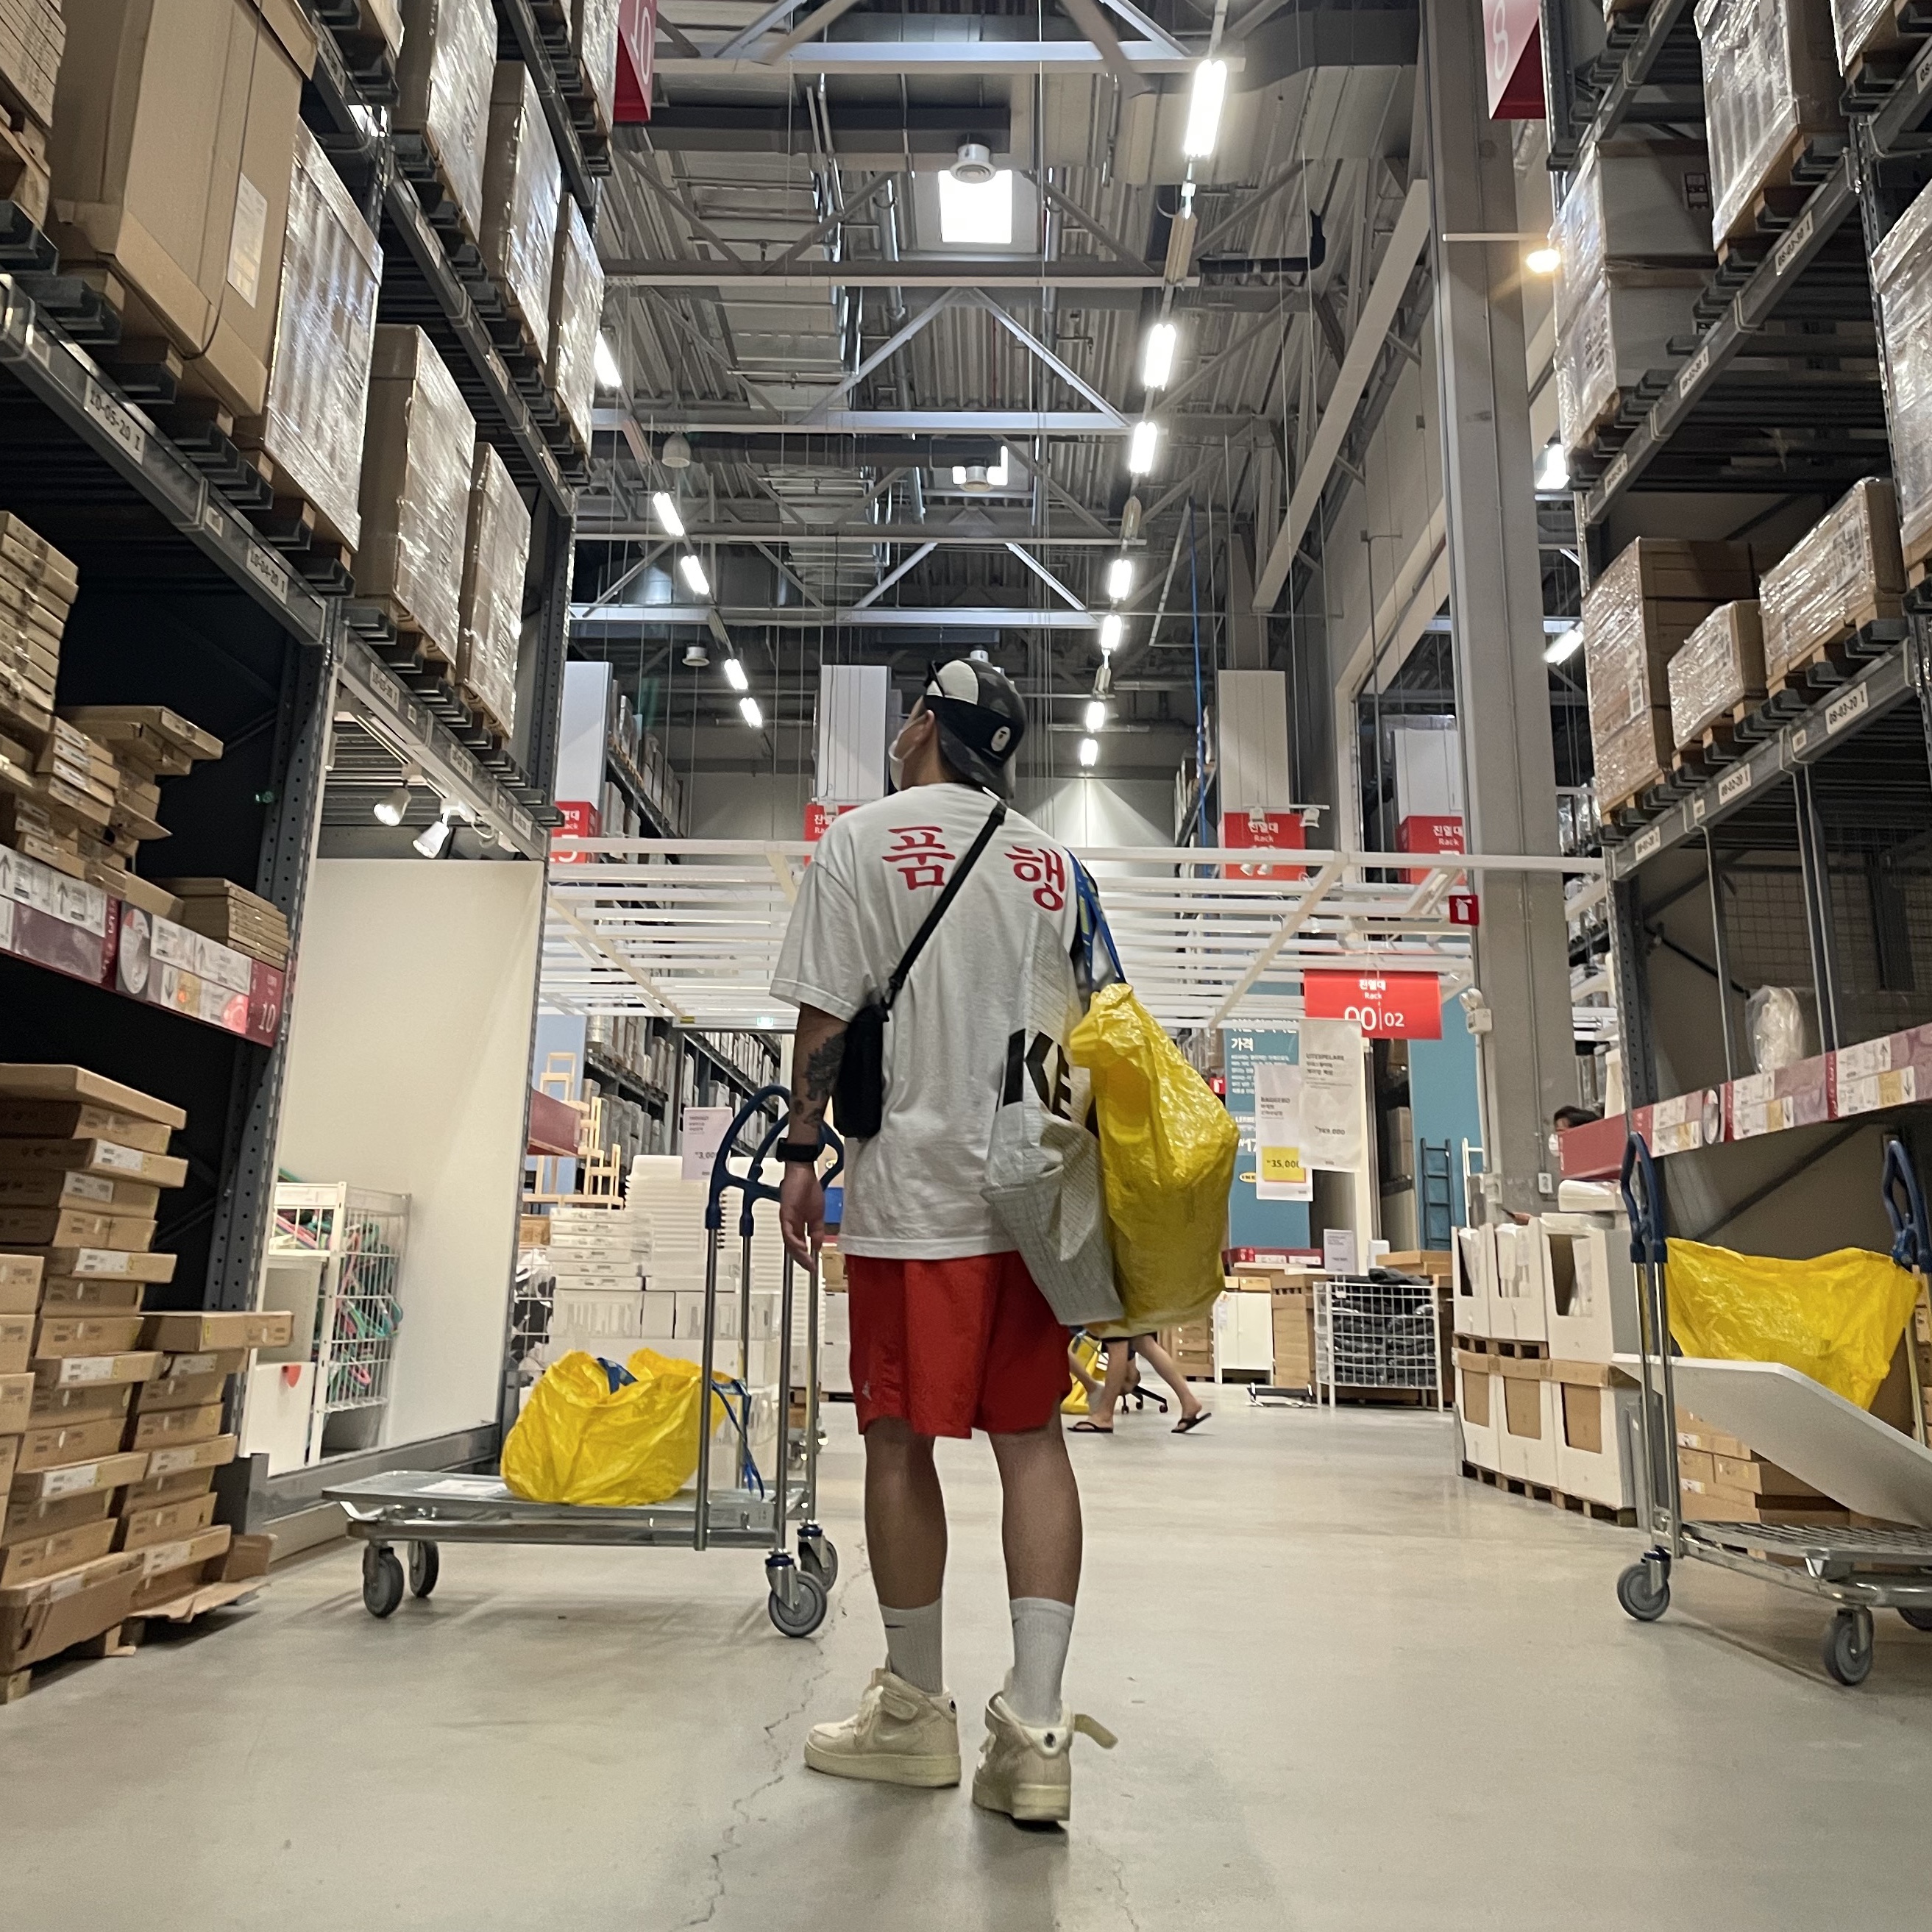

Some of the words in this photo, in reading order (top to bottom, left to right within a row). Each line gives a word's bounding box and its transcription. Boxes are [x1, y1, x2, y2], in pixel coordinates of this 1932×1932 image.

[1254, 834, 1274, 843] Rack
[1438, 837, 1460, 846] Rack
[881, 825, 956, 891] 품
[1004, 845, 1065, 912] 행
[1359, 979, 1386, 991] 진열대
[1364, 992, 1382, 1000] Rack
[258, 1001, 276, 1034] 10
[1384, 1012, 1404, 1027] 02
[1231, 1037, 1254, 1051] 가격
